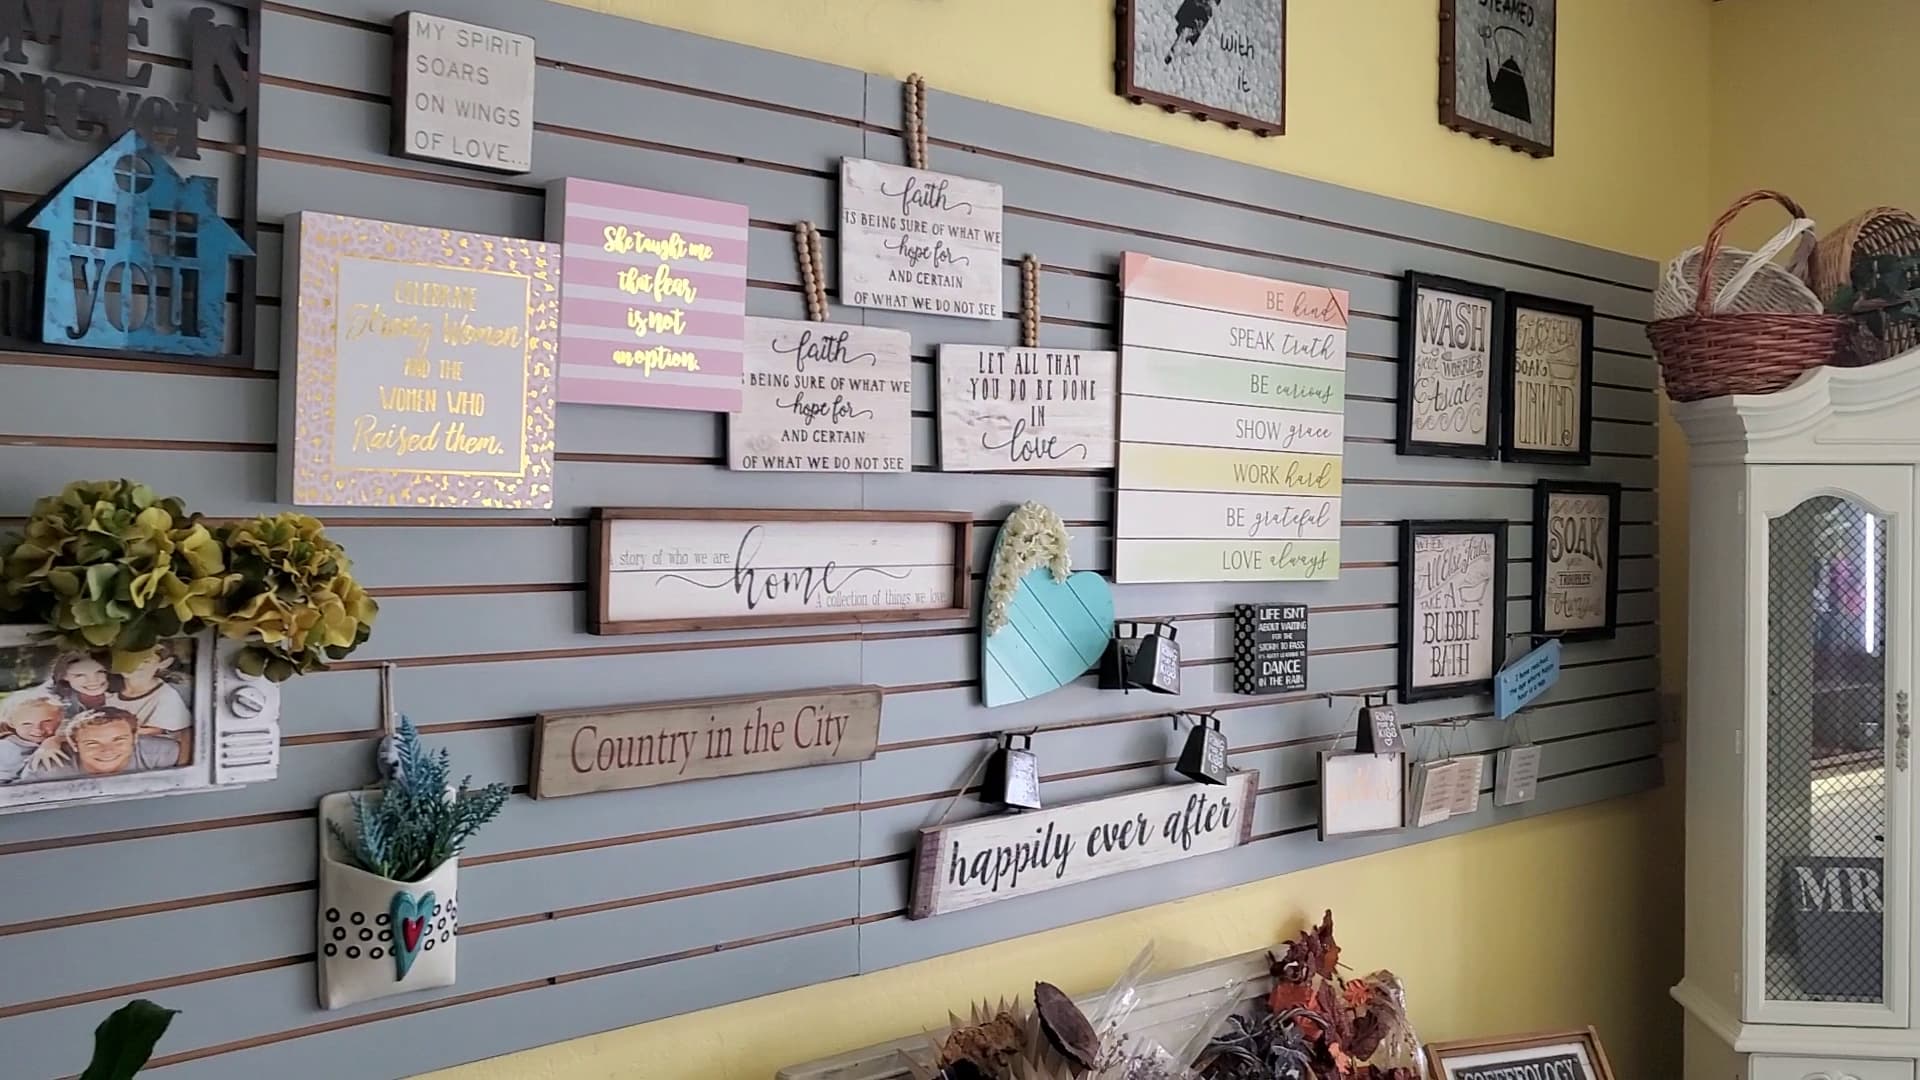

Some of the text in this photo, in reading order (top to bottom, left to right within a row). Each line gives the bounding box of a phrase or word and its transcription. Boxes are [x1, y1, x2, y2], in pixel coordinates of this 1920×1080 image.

[417, 21, 521, 56] MY SPIRIT
[416, 55, 489, 85] SOARS
[1237, 66, 1251, 93] it
[416, 93, 520, 127] ON WINGS
[415, 131, 528, 165] OF LOVE...
[881, 176, 972, 216] faith
[845, 211, 1001, 244] IS BEING SURE OF WHAT WE
[604, 226, 713, 261] She taught me
[884, 234, 969, 268] hope for
[617, 263, 697, 304] that fear
[889, 269, 963, 288] AND CERTAIN
[66, 255, 201, 340] you
[394, 280, 478, 311] CELEBRATE
[854, 291, 996, 316] OF WHAT WE DO NOT SEE
[1267, 290, 1337, 322] BE kind
[346, 303, 522, 355] Strong Women
[627, 308, 686, 337] is not
[1417, 294, 1487, 352] WASH
[612, 349, 634, 367] an
[772, 330, 876, 372] faith
[1229, 326, 1335, 361] SPEAK truth
[404, 357, 464, 381] AND THE
[979, 351, 1081, 376] LET ALL THAT
[750, 373, 789, 387] BEING
[794, 375, 825, 389] SURE
[831, 377, 845, 390] OF
[849, 378, 885, 392] WHAT
[891, 381, 911, 393] WE
[970, 378, 1096, 401] YOU DO BE DONE
[1250, 374, 1334, 404] BE curious
[379, 385, 485, 416] WOMEN WHO
[776, 391, 873, 425] hope for
[1031, 405, 1046, 427] IN
[352, 414, 504, 456] Raised them.
[781, 430, 865, 443] AND CERTAIN
[982, 418, 1087, 462] love
[1235, 418, 1332, 449] SHOW grace
[743, 456, 904, 470] OF WHAT WE DO NOT SEE
[1233, 460, 1332, 489] WORK hard
[1226, 501, 1331, 538] BE grateful
[1550, 516, 1603, 569] SOAK
[619, 550, 646, 570] story
[652, 549, 663, 565] of
[669, 549, 689, 565] who
[694, 553, 708, 565] we
[1223, 542, 1328, 579] LOVE always
[826, 590, 868, 607] collection
[872, 590, 881, 606] of
[885, 588, 911, 610] things
[914, 591, 926, 604] we
[1260, 607, 1280, 621] LIFE
[1258, 621, 1306, 632] ABOUT WAITING
[1423, 609, 1480, 644] BUBBLE
[1289, 640, 1305, 650] PASS
[1430, 642, 1470, 678] BATH
[1258, 674, 1304, 688] IN THE RAIN
[1263, 659, 1302, 676] DANCE
[571, 704, 850, 775] Country in the City
[949, 793, 1238, 892] happily ever after
